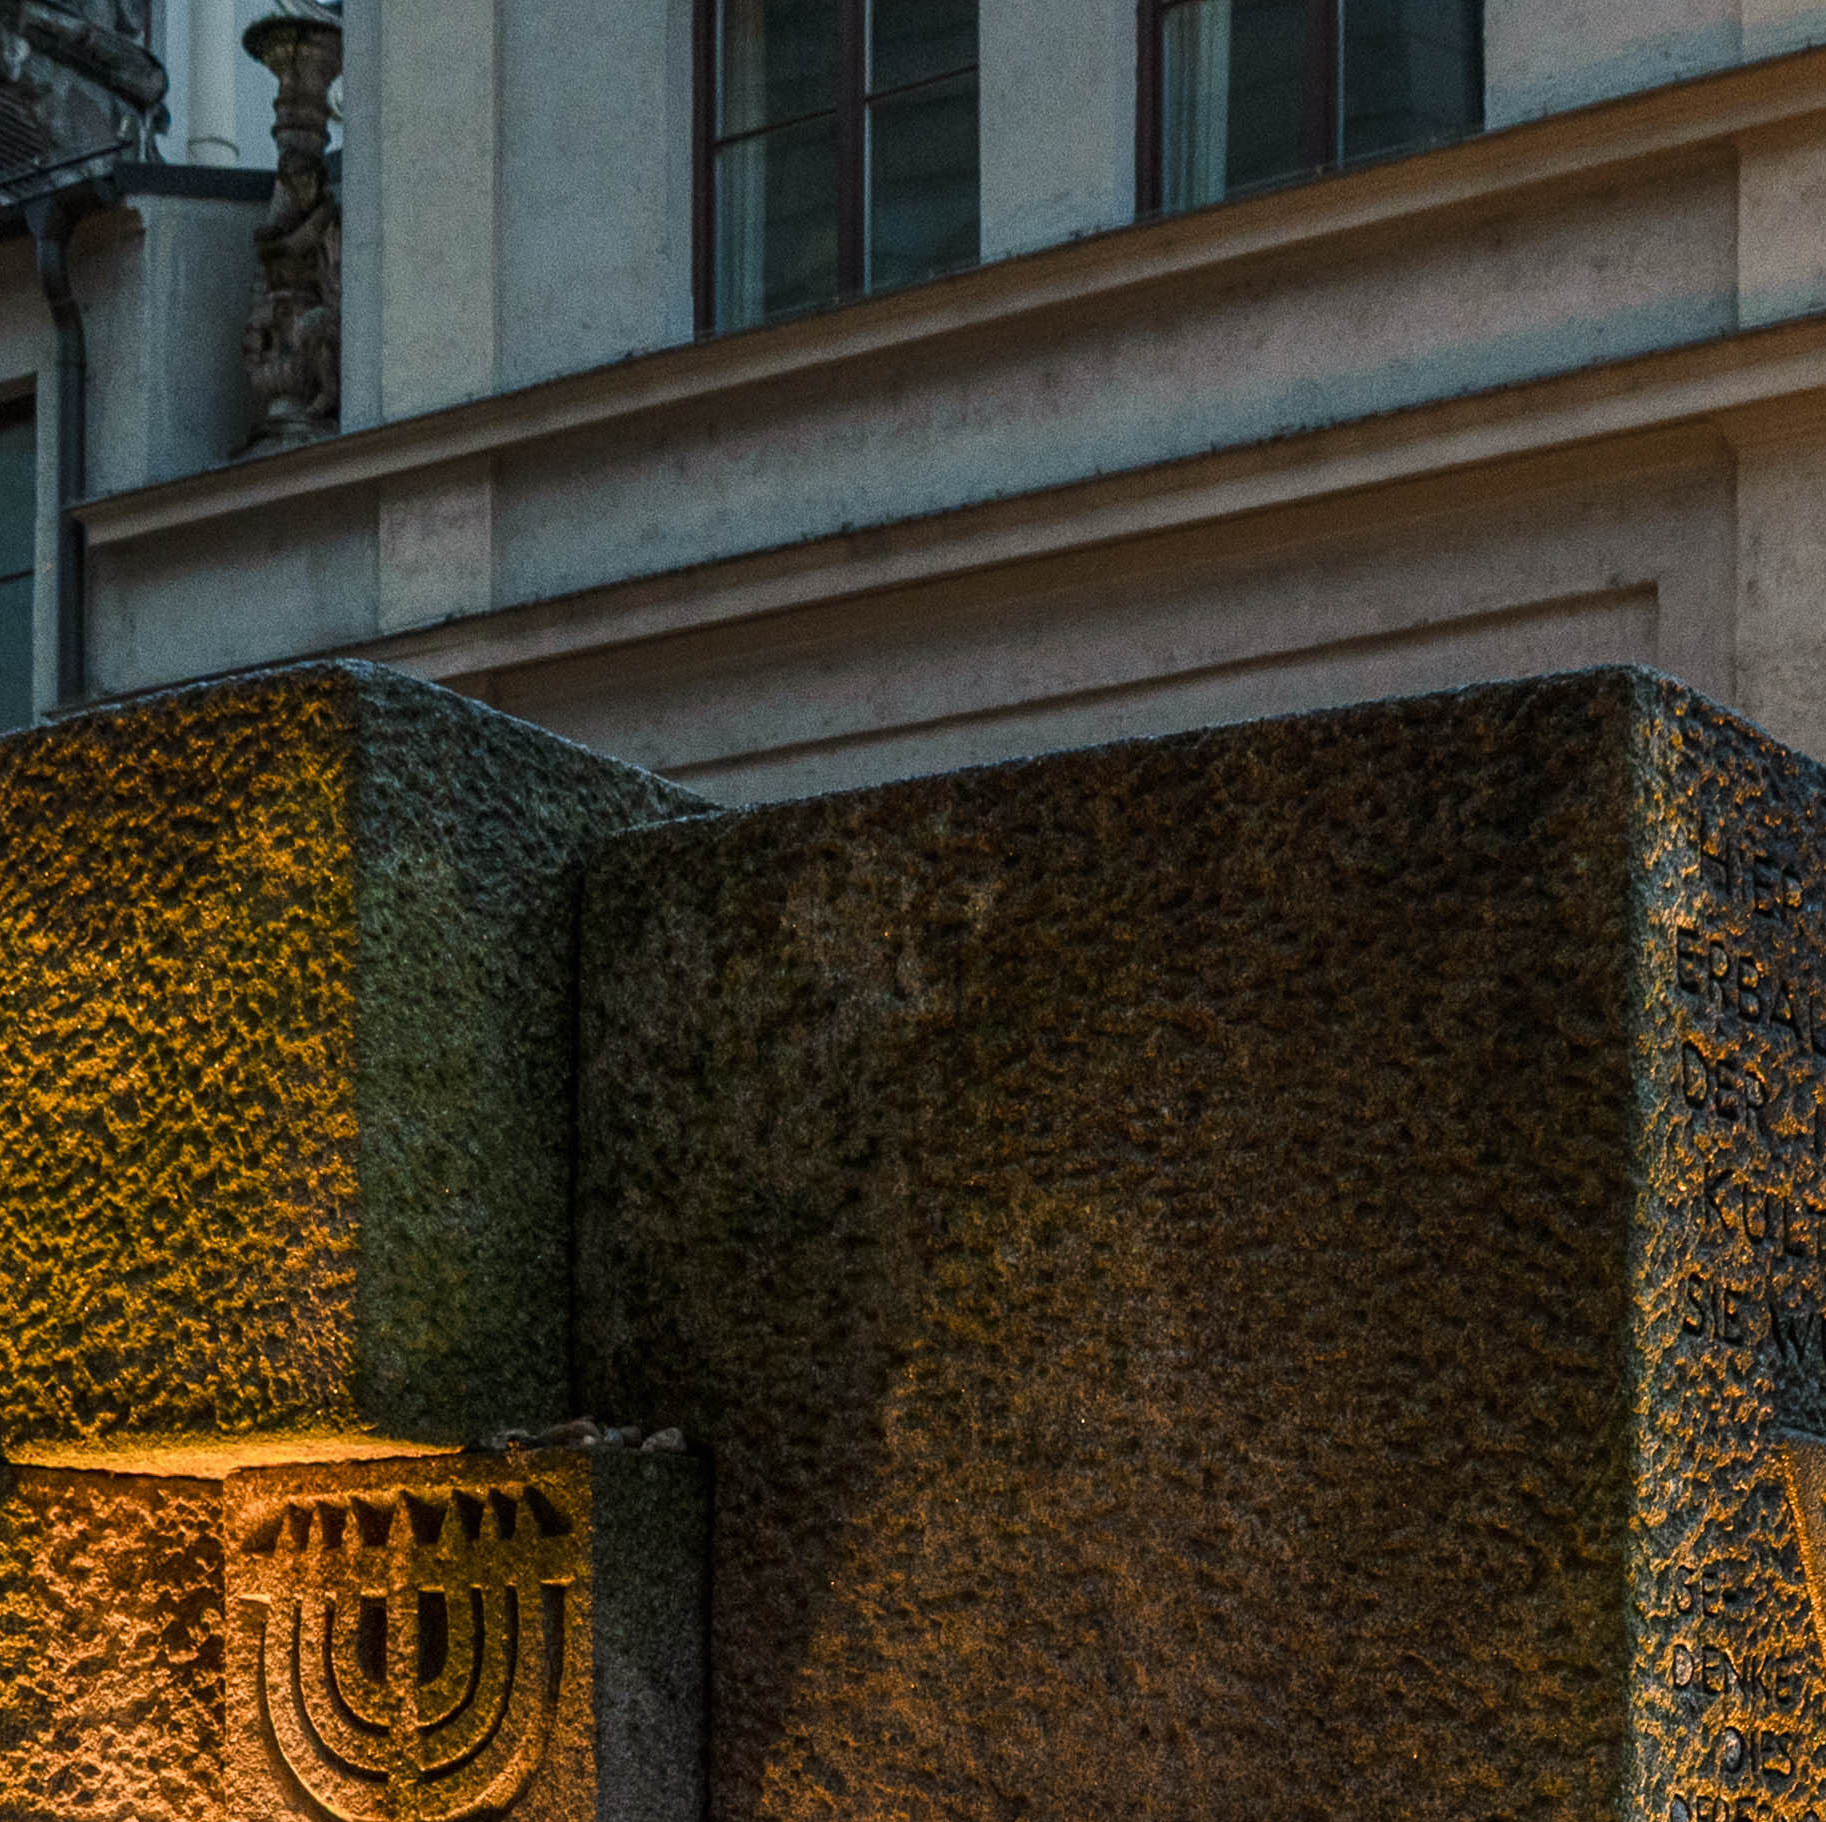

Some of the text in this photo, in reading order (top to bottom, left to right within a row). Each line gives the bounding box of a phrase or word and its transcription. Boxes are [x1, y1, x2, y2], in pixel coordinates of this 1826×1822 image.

[1680, 1037, 1766, 1138] DER
[1681, 1269, 1744, 1351] SIE
[1673, 1641, 1791, 1708] DENKE
[1723, 1724, 1795, 1782] DIES
